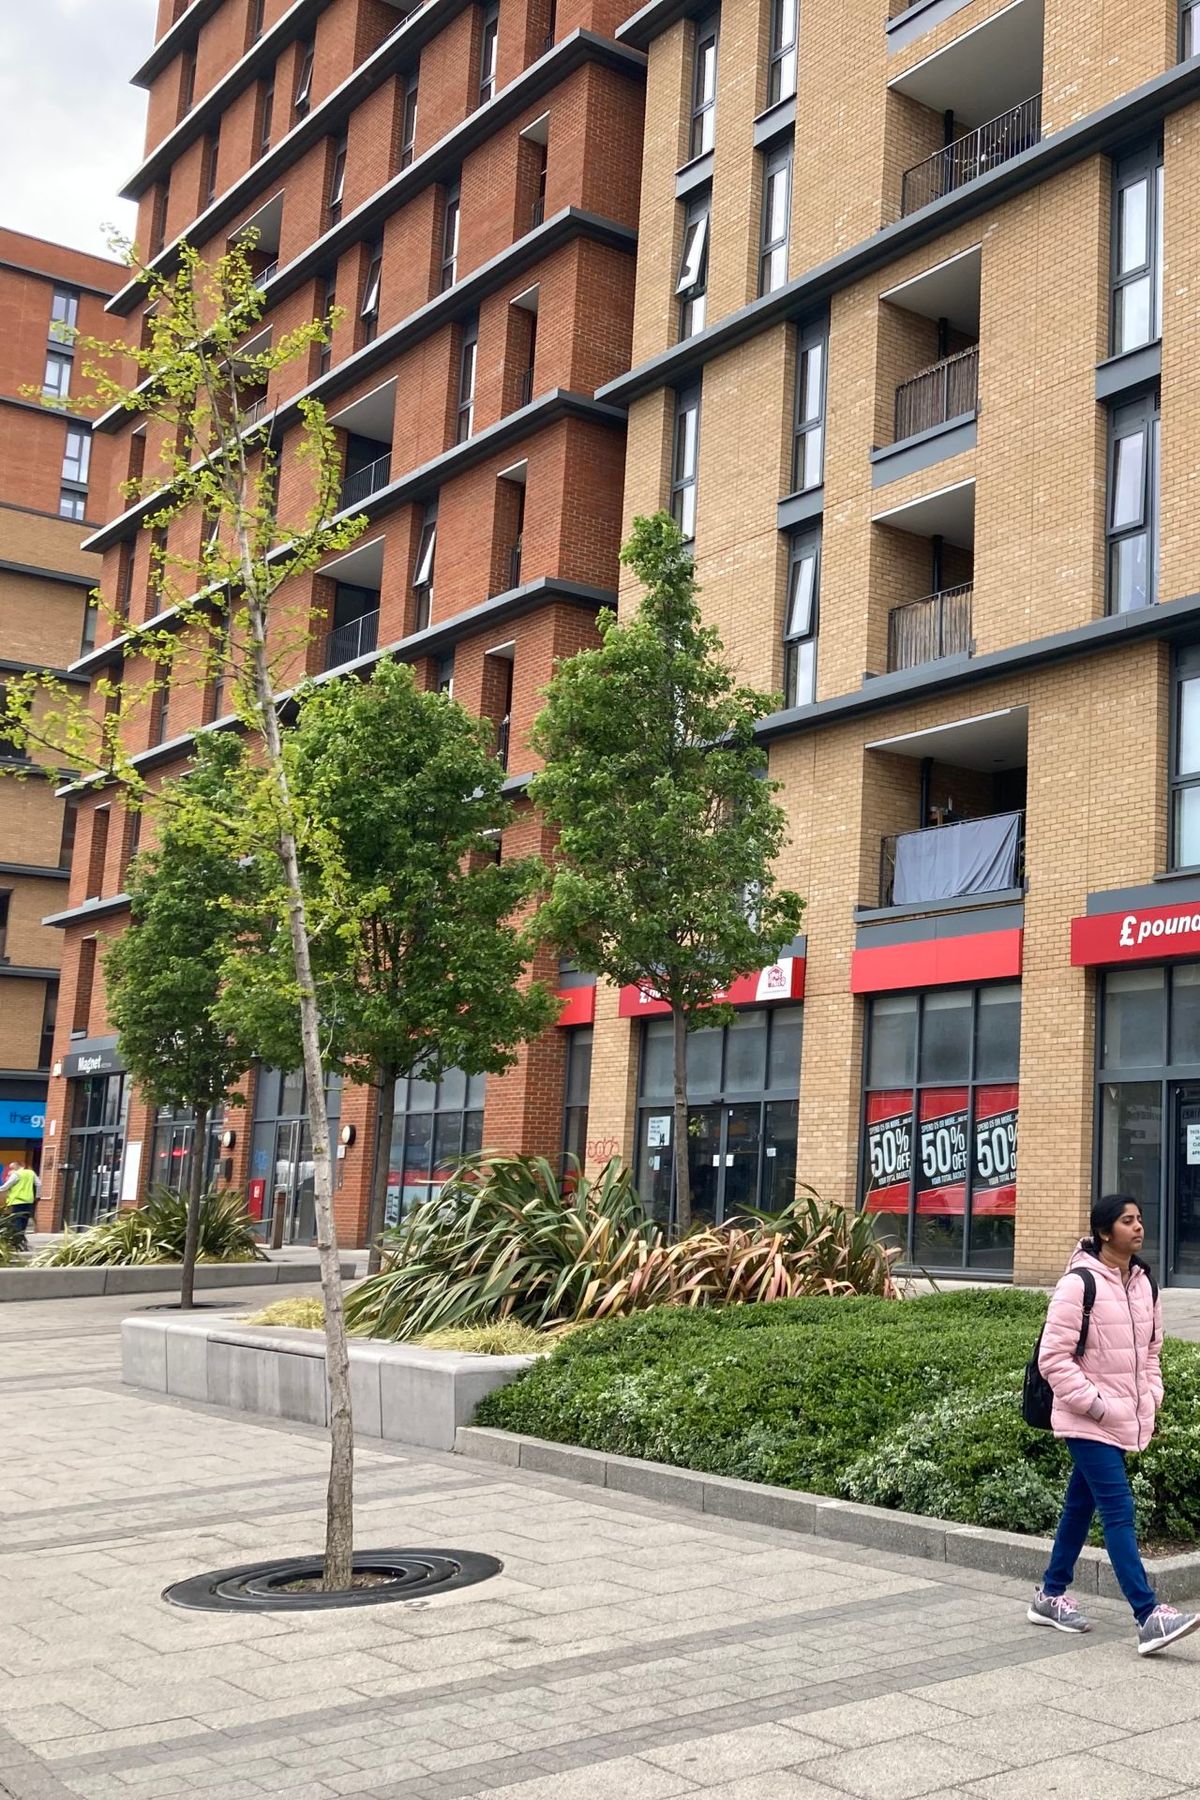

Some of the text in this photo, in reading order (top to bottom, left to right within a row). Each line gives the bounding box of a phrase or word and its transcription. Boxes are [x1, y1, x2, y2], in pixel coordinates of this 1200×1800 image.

[78, 1055, 102, 1073] Magnet
[869, 1126, 909, 1178] 50%
[921, 1124, 965, 1177] 50%
[896, 1151, 911, 1171] OFF
[952, 1151, 967, 1171] OFF
